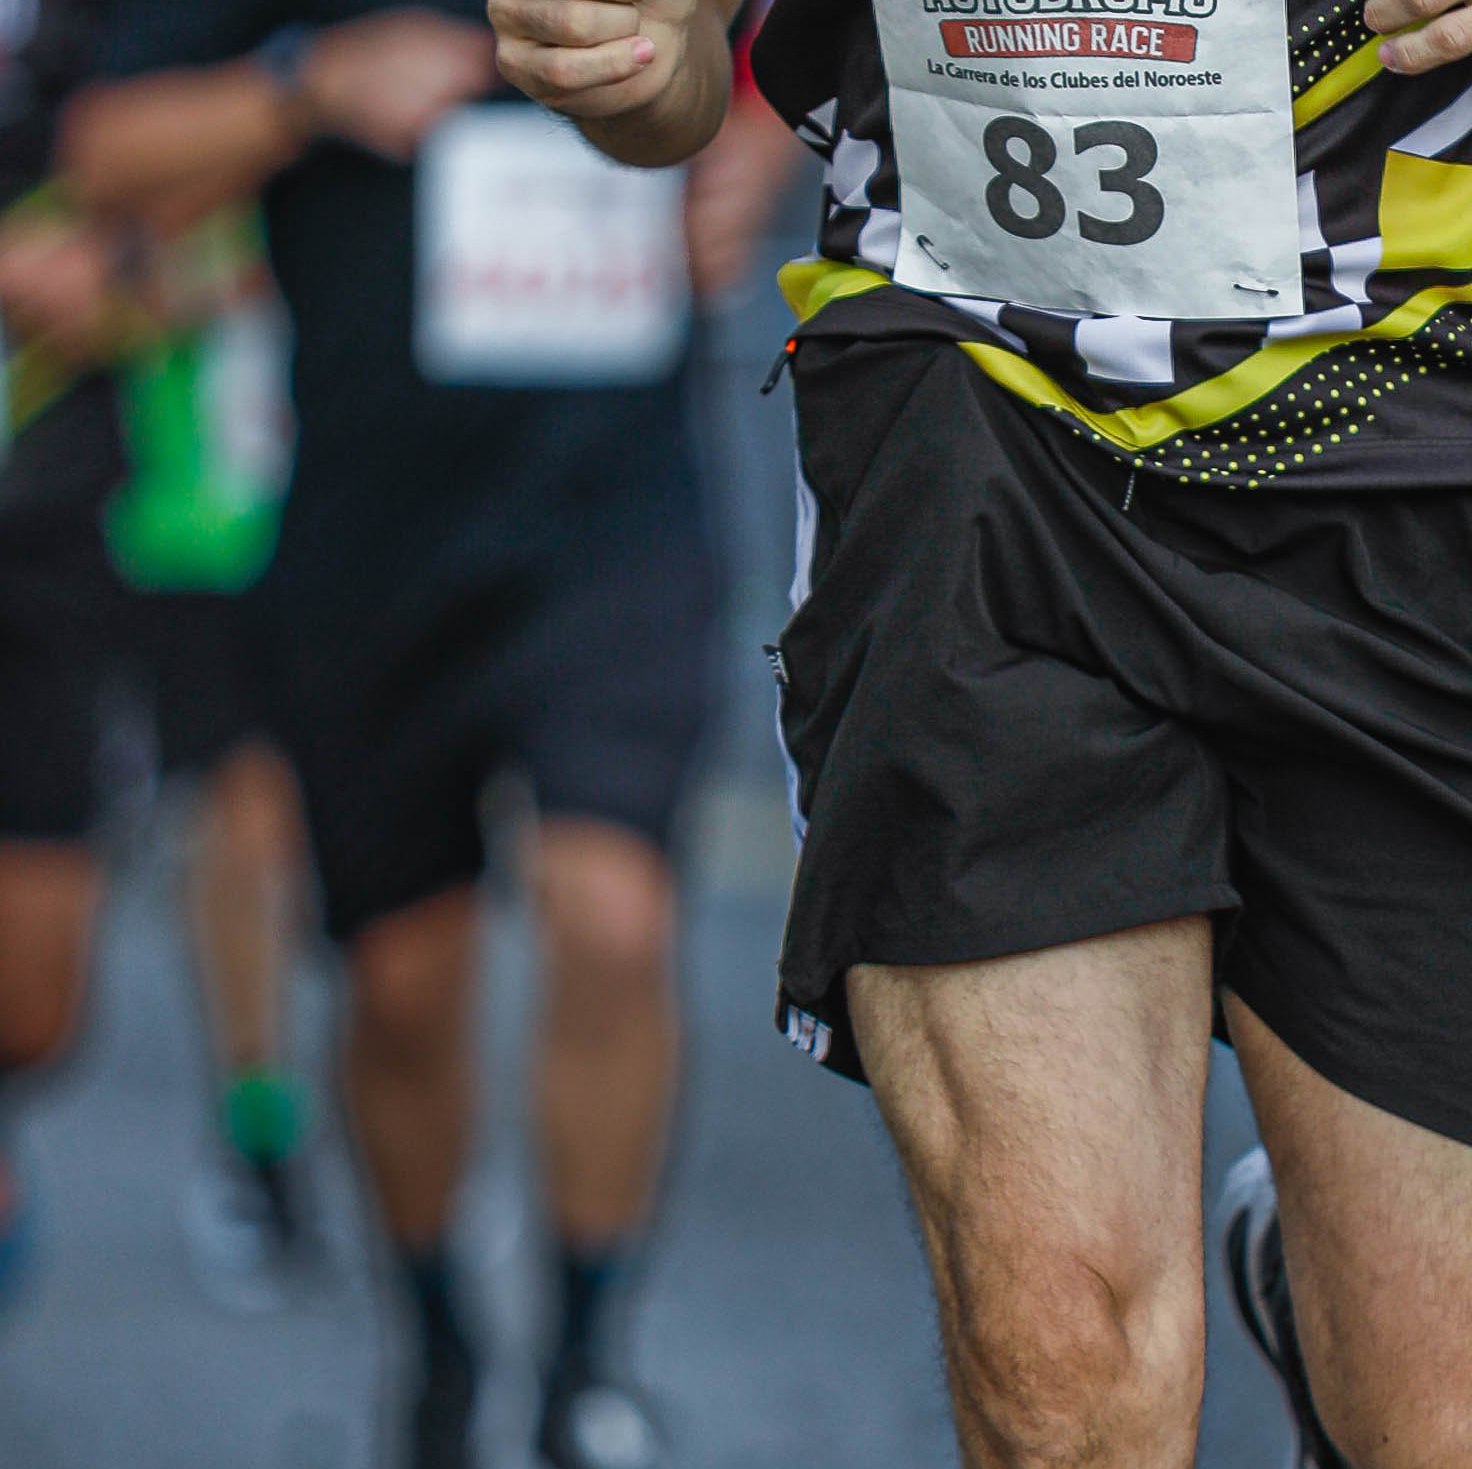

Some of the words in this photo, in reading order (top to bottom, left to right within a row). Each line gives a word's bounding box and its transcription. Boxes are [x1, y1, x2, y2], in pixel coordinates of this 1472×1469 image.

[963, 22, 1080, 54] RUNNING
[1090, 23, 1165, 57] RACE
[927, 58, 945, 76] La
[946, 62, 997, 84] Carrera
[1000, 70, 1020, 87] de
[1023, 71, 1047, 89] los
[1050, 71, 1109, 89] Clubes
[1113, 71, 1140, 87] del
[1145, 69, 1223, 88] Noroeste
[982, 115, 1165, 246] 83
